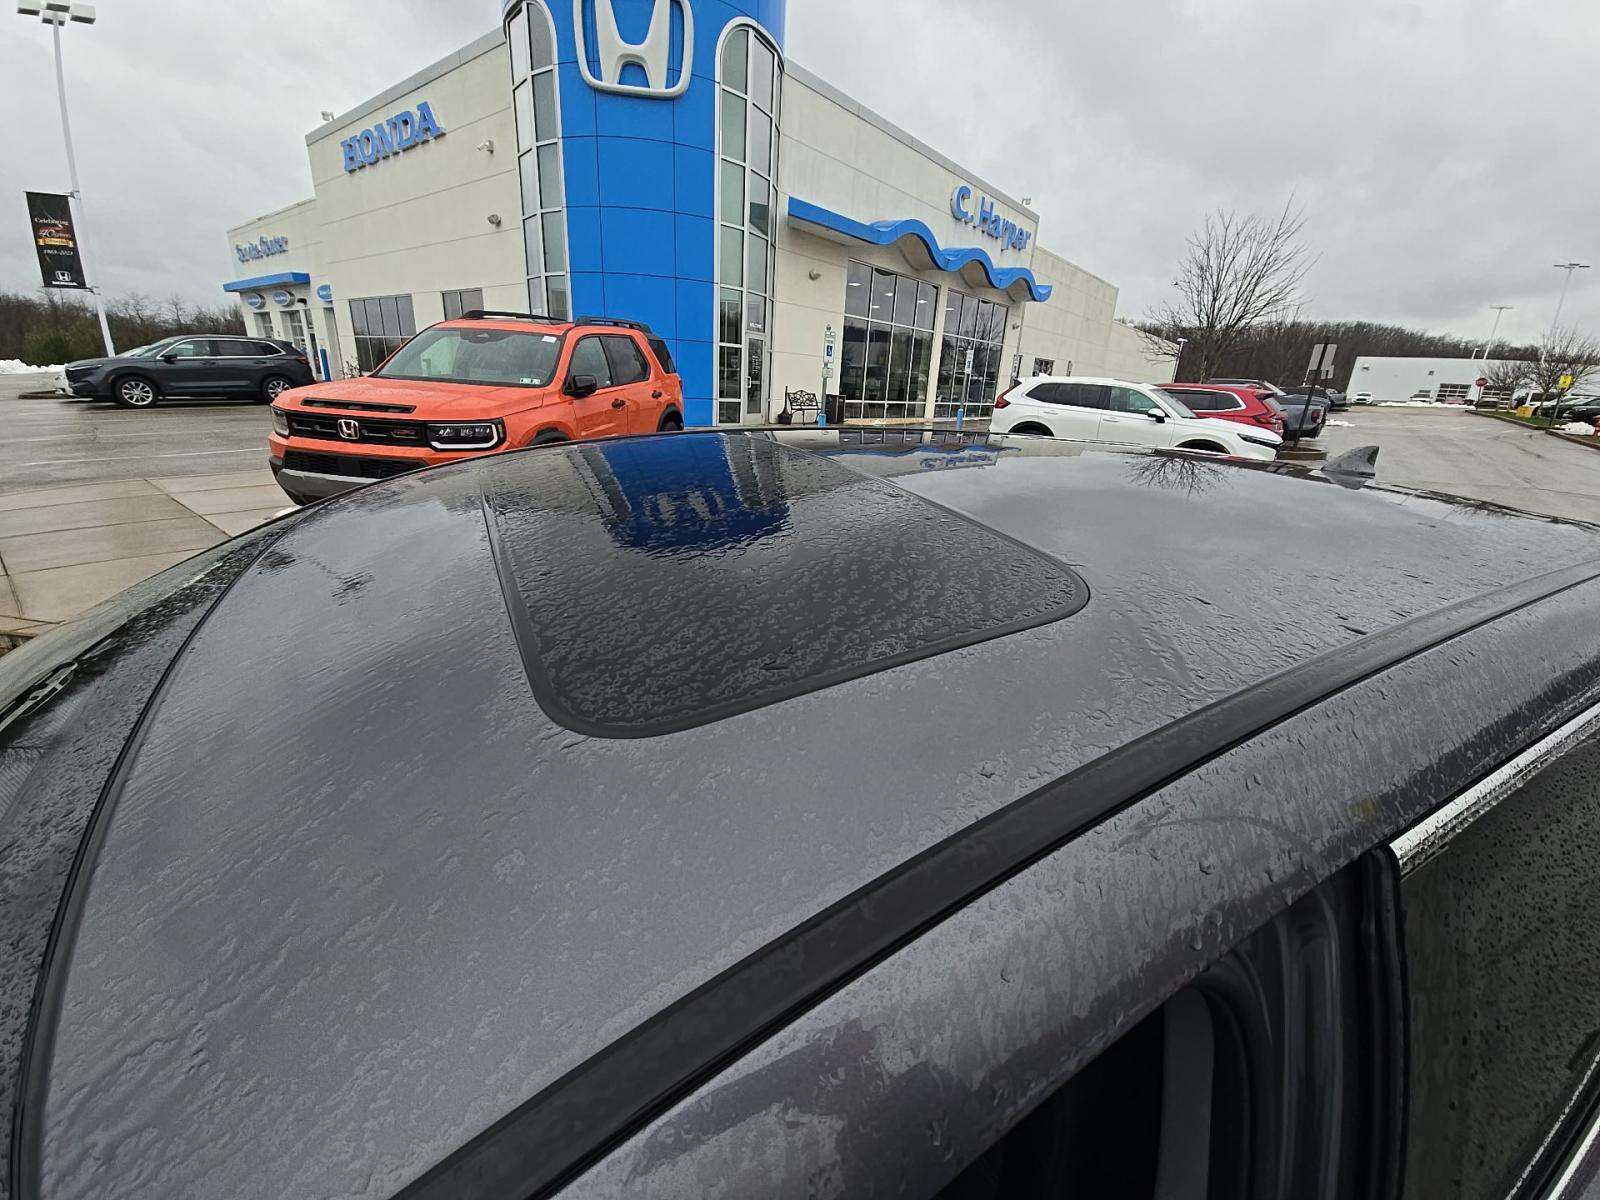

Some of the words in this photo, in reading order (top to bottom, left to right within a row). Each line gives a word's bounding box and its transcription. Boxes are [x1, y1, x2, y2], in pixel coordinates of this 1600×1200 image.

[340, 101, 444, 172] HONDA
[951, 186, 975, 222] C.
[979, 196, 1031, 250] Harper
